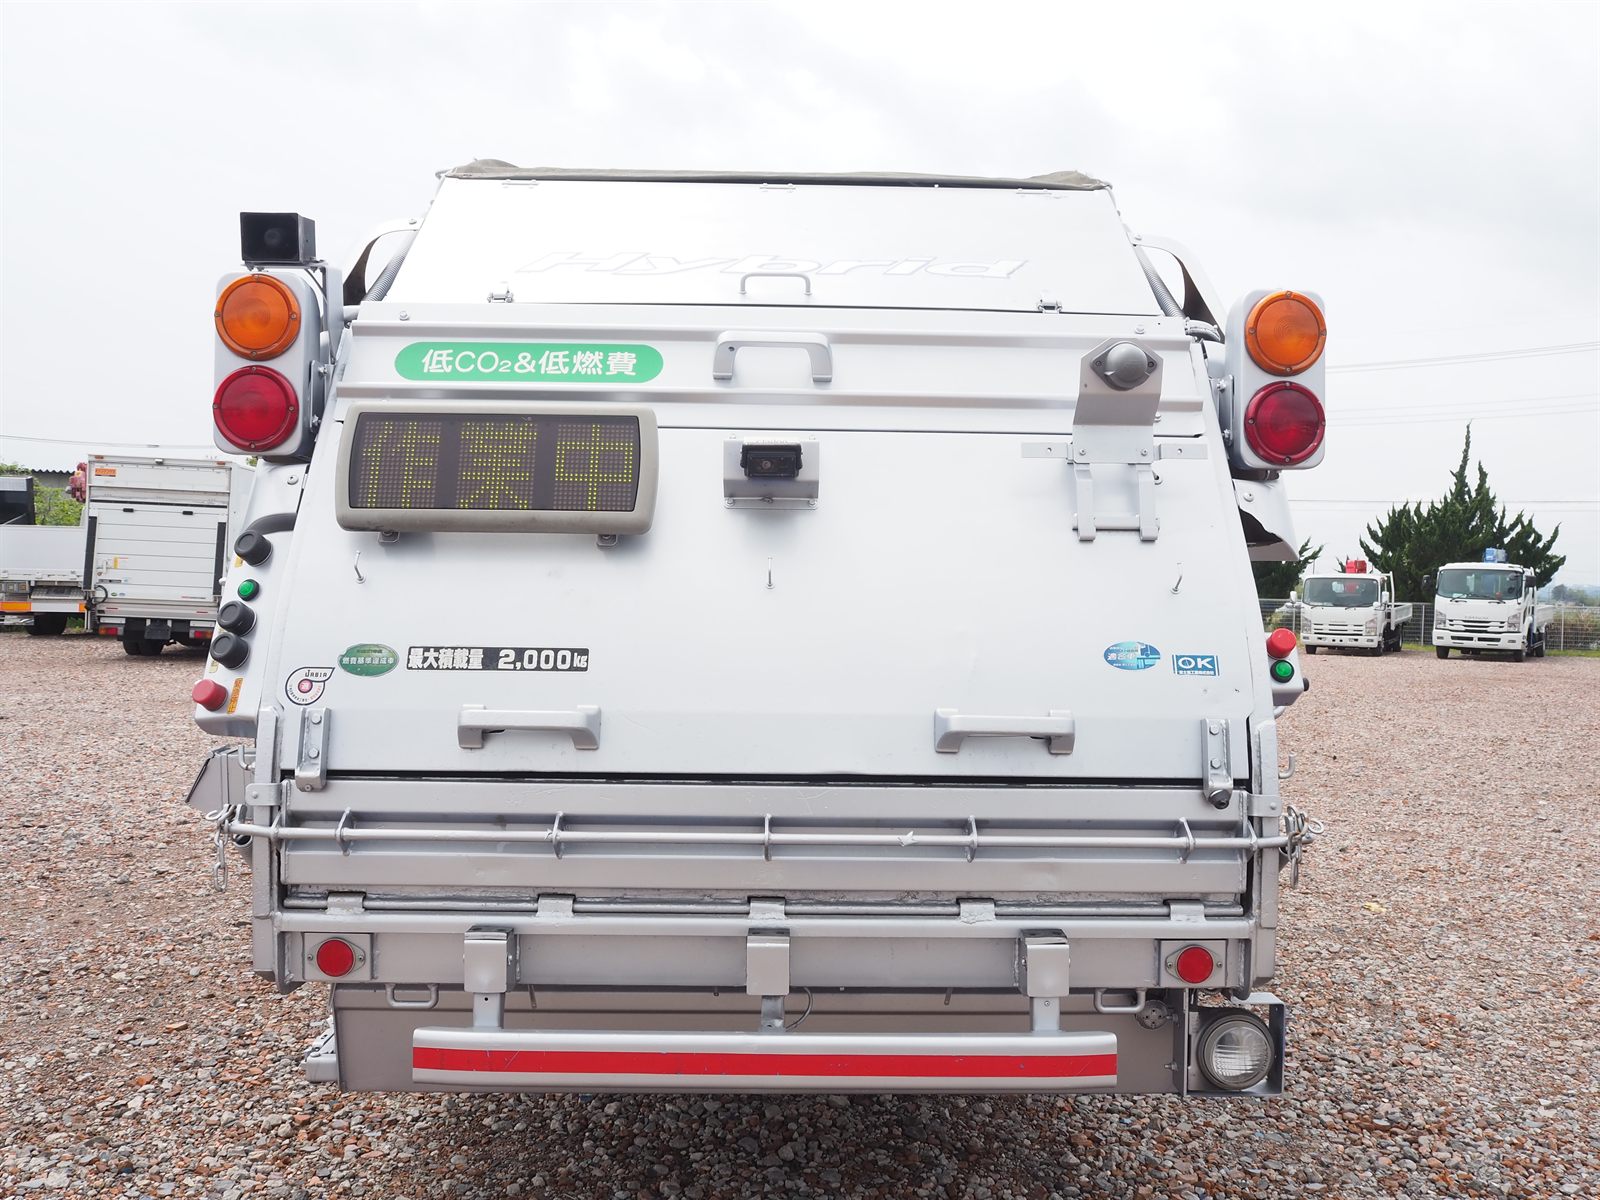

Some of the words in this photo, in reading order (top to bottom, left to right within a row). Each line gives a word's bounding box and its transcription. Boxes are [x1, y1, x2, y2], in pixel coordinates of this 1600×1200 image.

[515, 252, 1029, 279] Hybrid
[362, 421, 633, 511] 作業中
[408, 648, 484, 669] 最大積載量
[1178, 657, 1213, 669] OK
